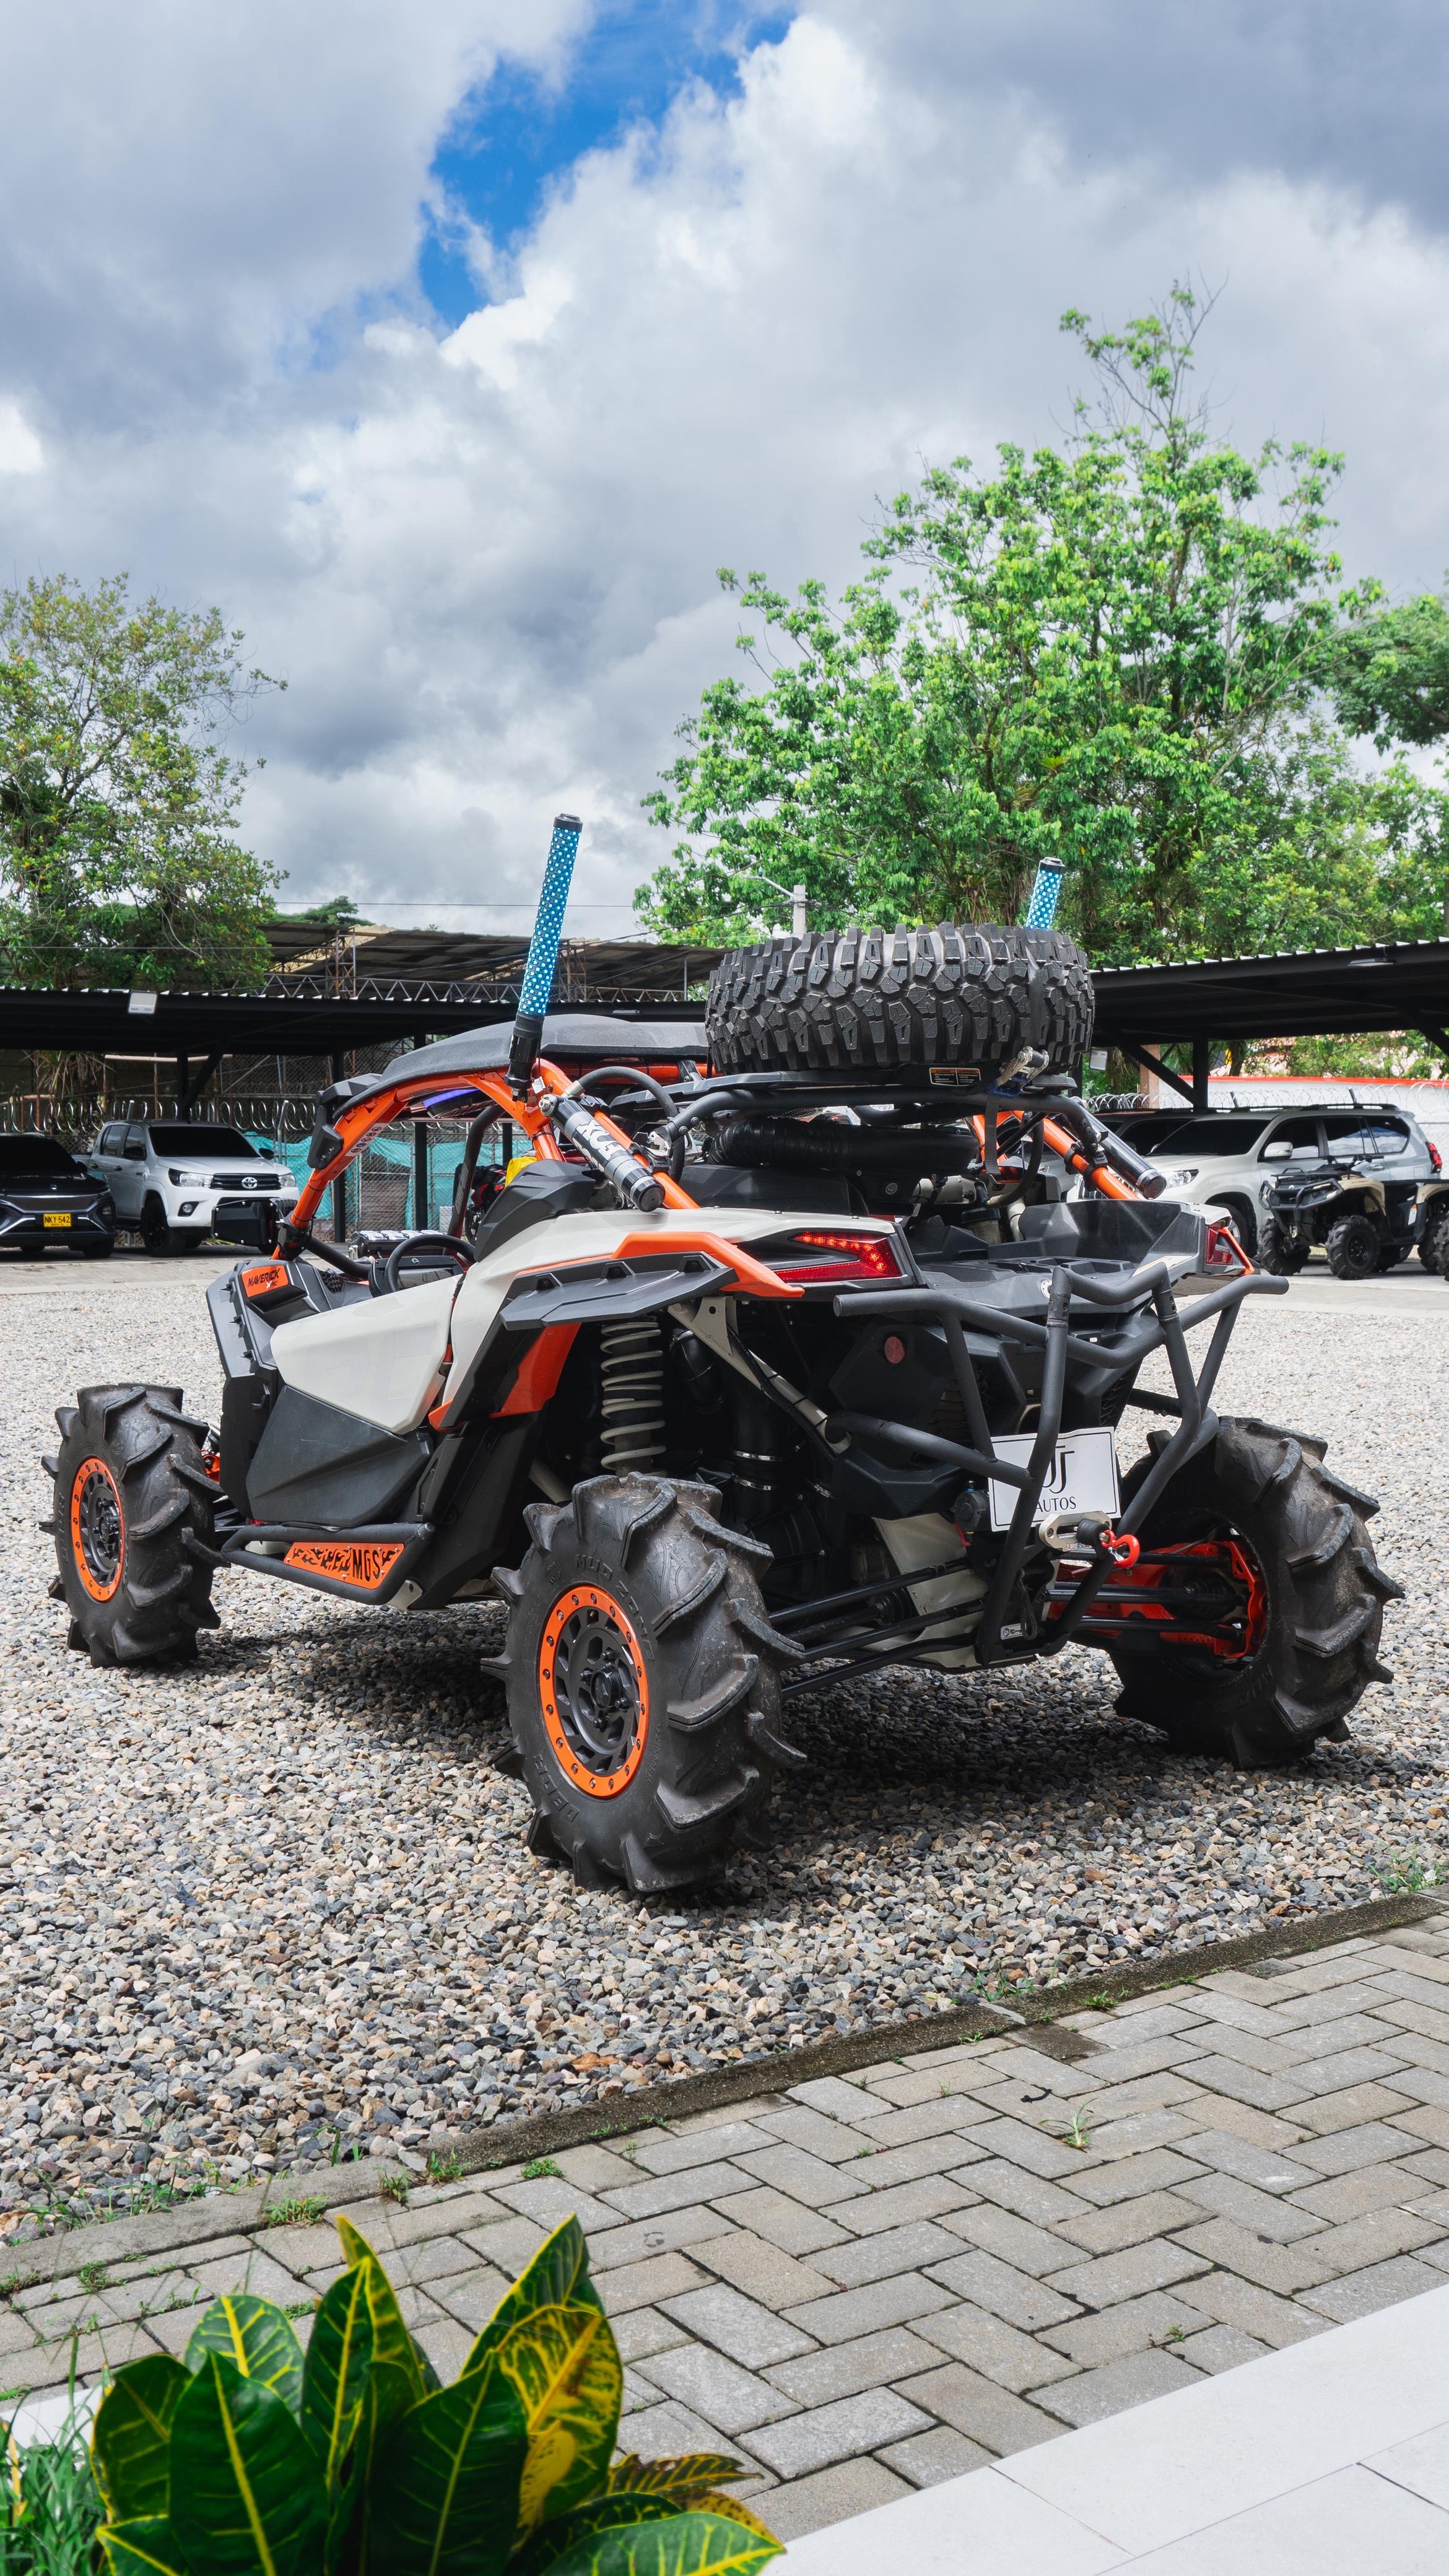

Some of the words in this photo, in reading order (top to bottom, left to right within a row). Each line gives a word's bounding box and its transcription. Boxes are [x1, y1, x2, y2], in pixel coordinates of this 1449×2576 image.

[248, 1268, 280, 1287] MAVERICK
[1036, 1496, 1076, 1512] AUTOS
[352, 1549, 380, 1582] MGS
[575, 1554, 613, 1579] MUD
[615, 1580, 655, 1660] ZONE
